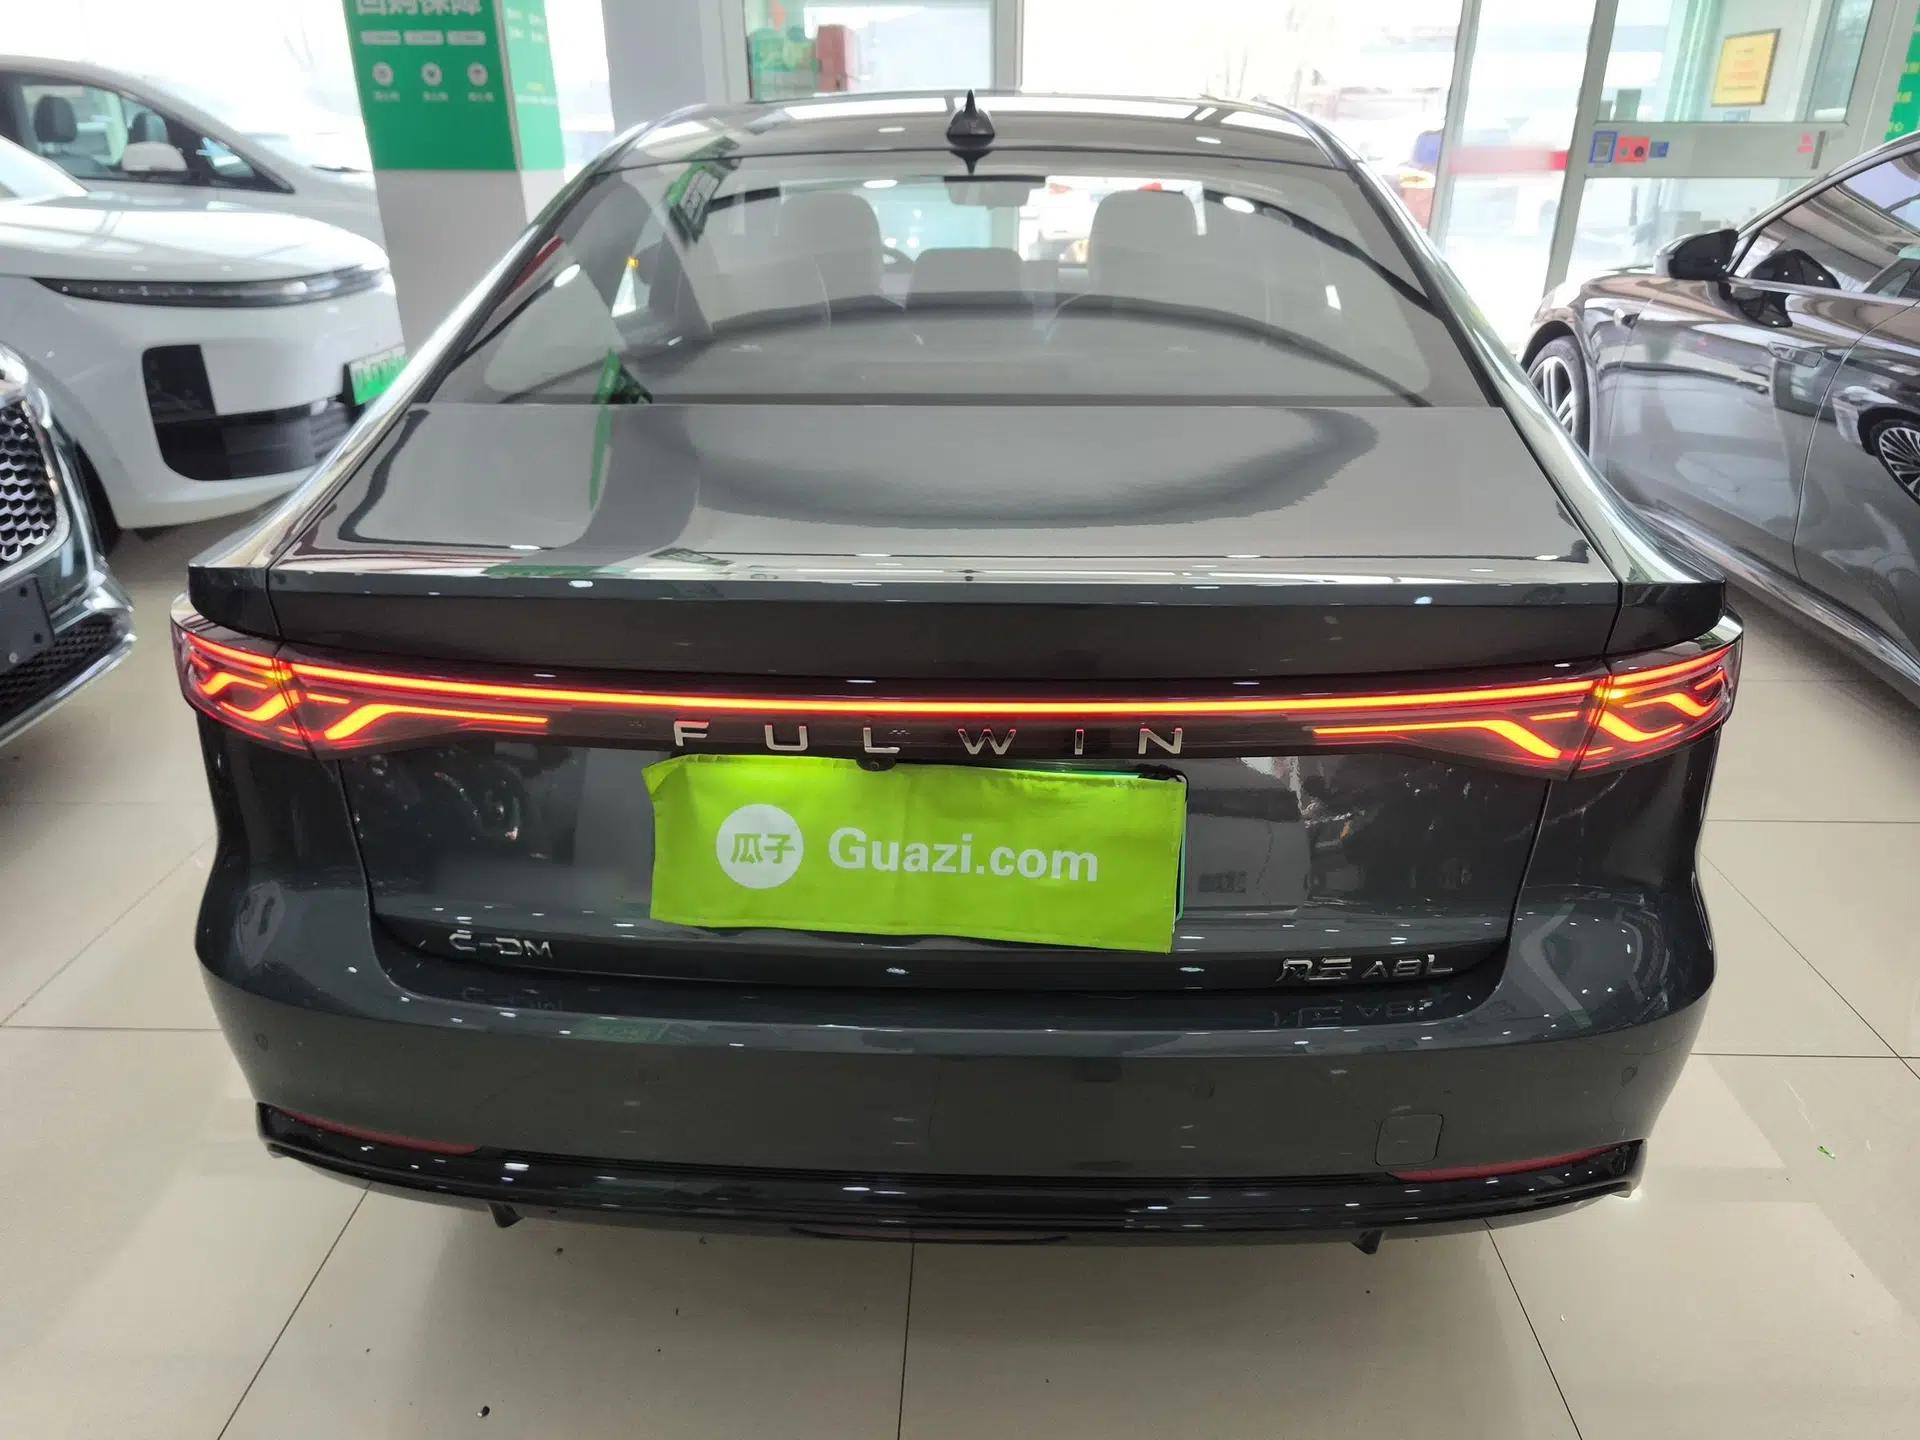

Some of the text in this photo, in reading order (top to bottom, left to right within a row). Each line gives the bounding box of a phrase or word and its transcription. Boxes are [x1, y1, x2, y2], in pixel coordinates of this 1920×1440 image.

[674, 720, 1182, 753] FULWIN
[730, 832, 796, 864] 瓜子
[828, 827, 1098, 881] Guazi.com
